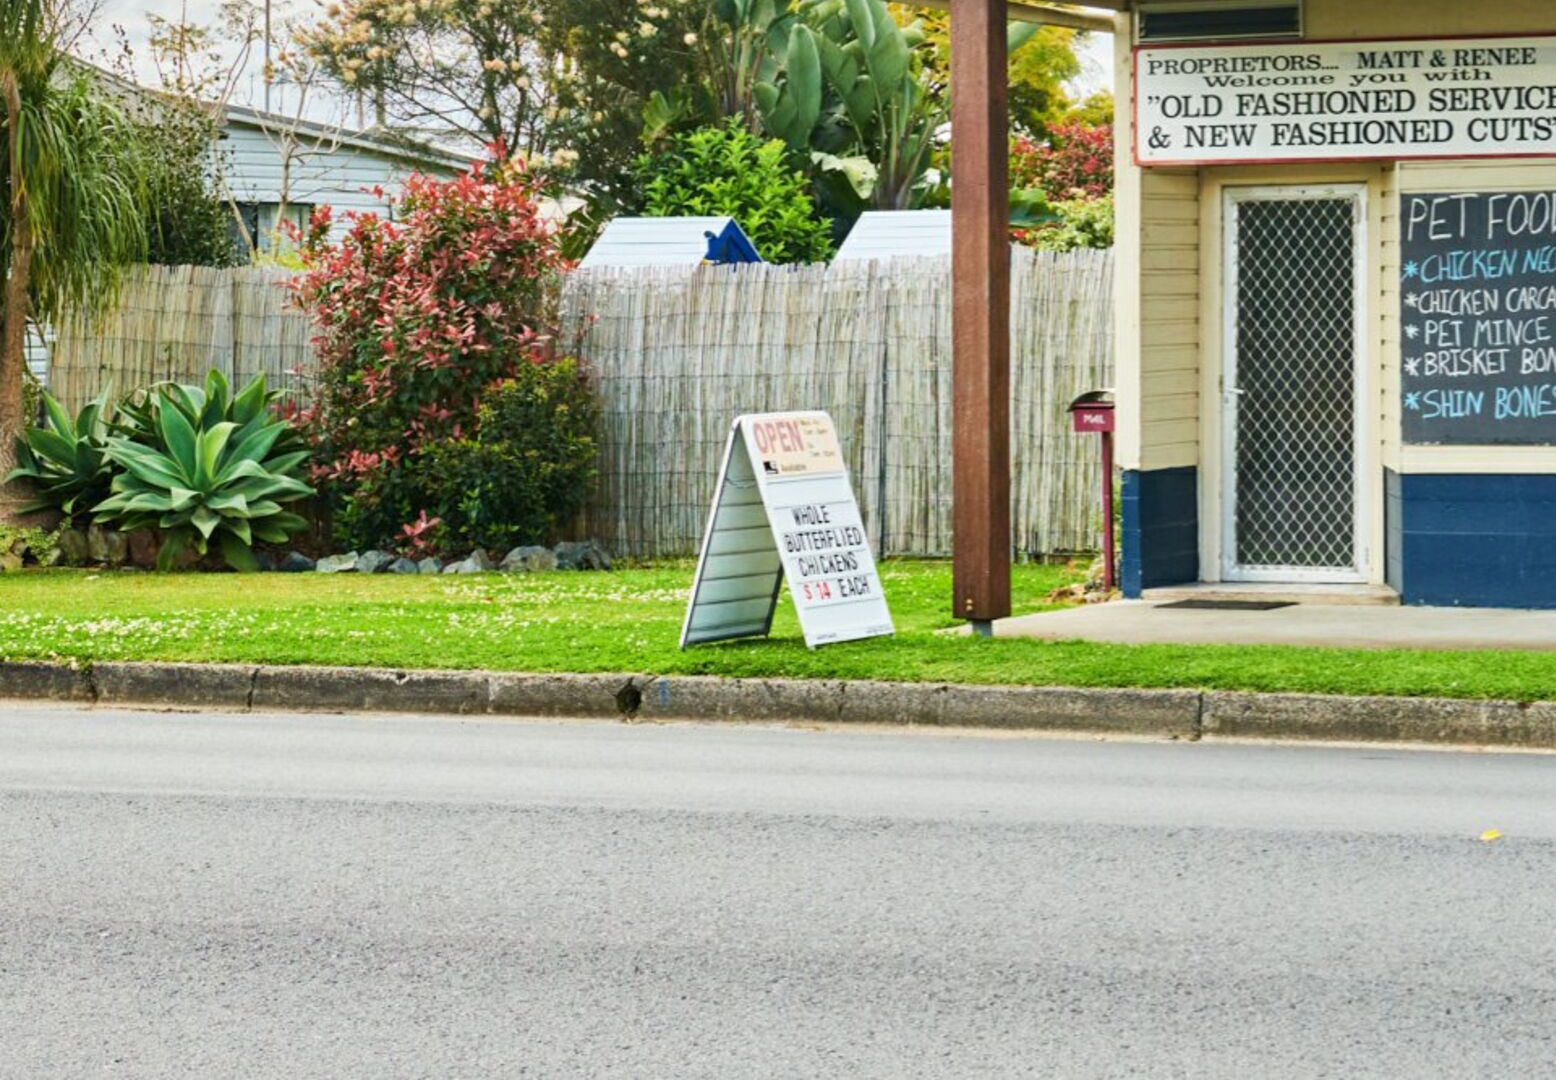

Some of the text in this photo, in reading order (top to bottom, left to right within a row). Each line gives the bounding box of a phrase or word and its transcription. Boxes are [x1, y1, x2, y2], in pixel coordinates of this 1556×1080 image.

[1357, 51, 1424, 69] MATT
[1429, 49, 1447, 67] &
[1454, 47, 1536, 66] RENEE
[1203, 69, 1492, 88] Welcome you with
[1236, 90, 1416, 117] FASHIONED
[1148, 125, 1171, 149] &
[1184, 124, 1257, 148] NEW
[1271, 120, 1454, 146] FASHIONED
[1407, 193, 1479, 241] PET
[1420, 249, 1517, 282] CHICKEN
[1418, 288, 1498, 316] CHICKEN
[1424, 316, 1551, 347] PET MINCE
[1424, 347, 1510, 376] BRISKET
[1422, 389, 1484, 418] SHIN
[753, 421, 804, 454] OPEN
[792, 505, 830, 525] WHOLE
[784, 527, 862, 552] BUTTERFLIED
[799, 551, 858, 576] CHICKENS
[838, 576, 871, 597] EACH
